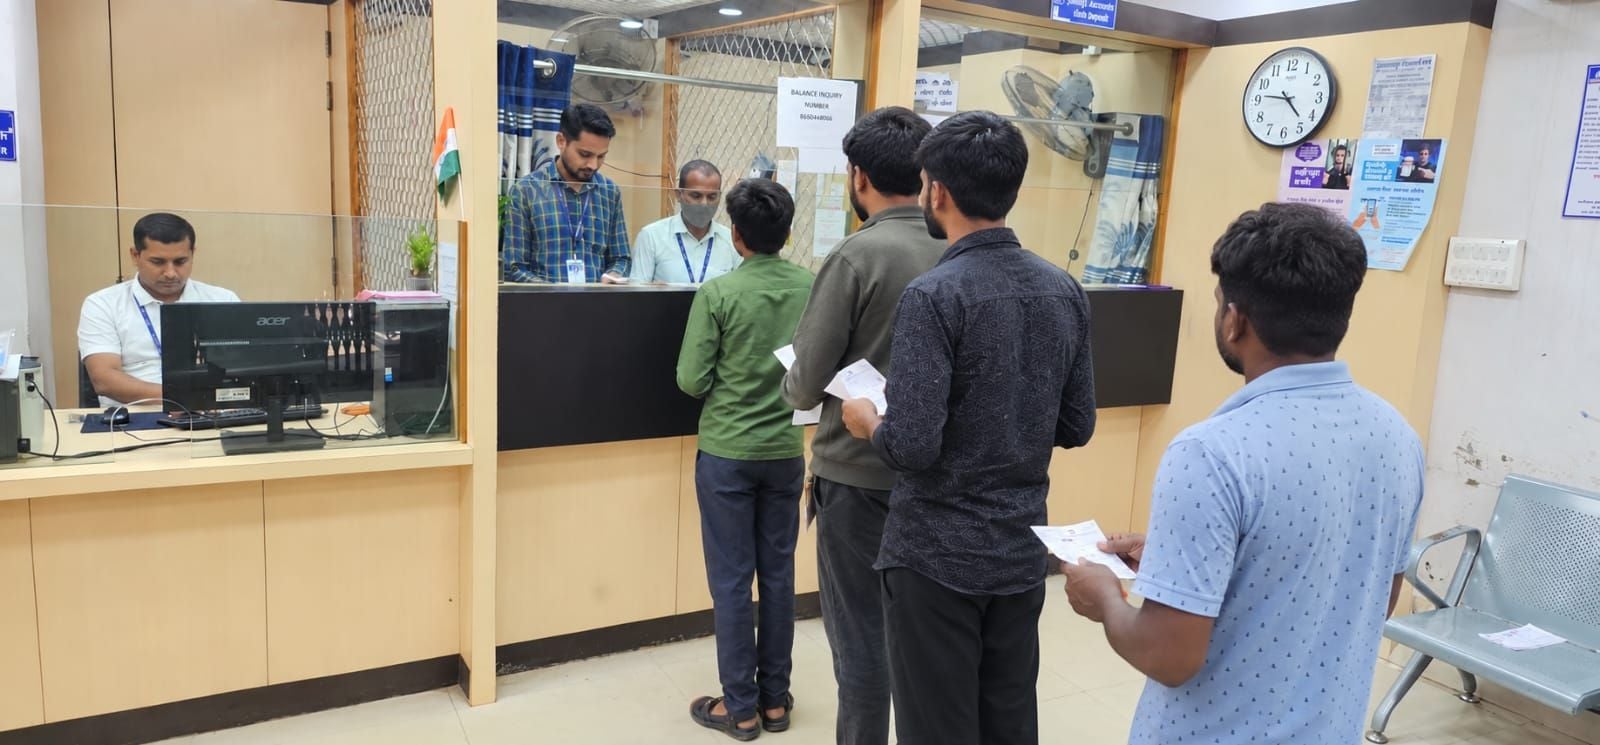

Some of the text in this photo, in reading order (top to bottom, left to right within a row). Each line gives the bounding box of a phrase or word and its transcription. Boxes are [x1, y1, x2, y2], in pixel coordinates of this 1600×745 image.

[1271, 64, 1280, 77] 11
[1287, 58, 1299, 72] 12
[1305, 61, 1310, 75] 1
[1259, 78, 1270, 90] 10
[1312, 73, 1321, 87] 2
[790, 88, 843, 99] BALANCE INQUIRY
[1254, 94, 1262, 106] 9
[1314, 91, 1323, 105] 3
[804, 101, 829, 109] NUMBER
[1256, 111, 1264, 123] 8
[1308, 108, 1315, 122] 4
[1266, 123, 1274, 136] 7
[1280, 126, 1287, 139] 6
[1295, 122, 1304, 135] 5
[256, 316, 291, 326] acer
